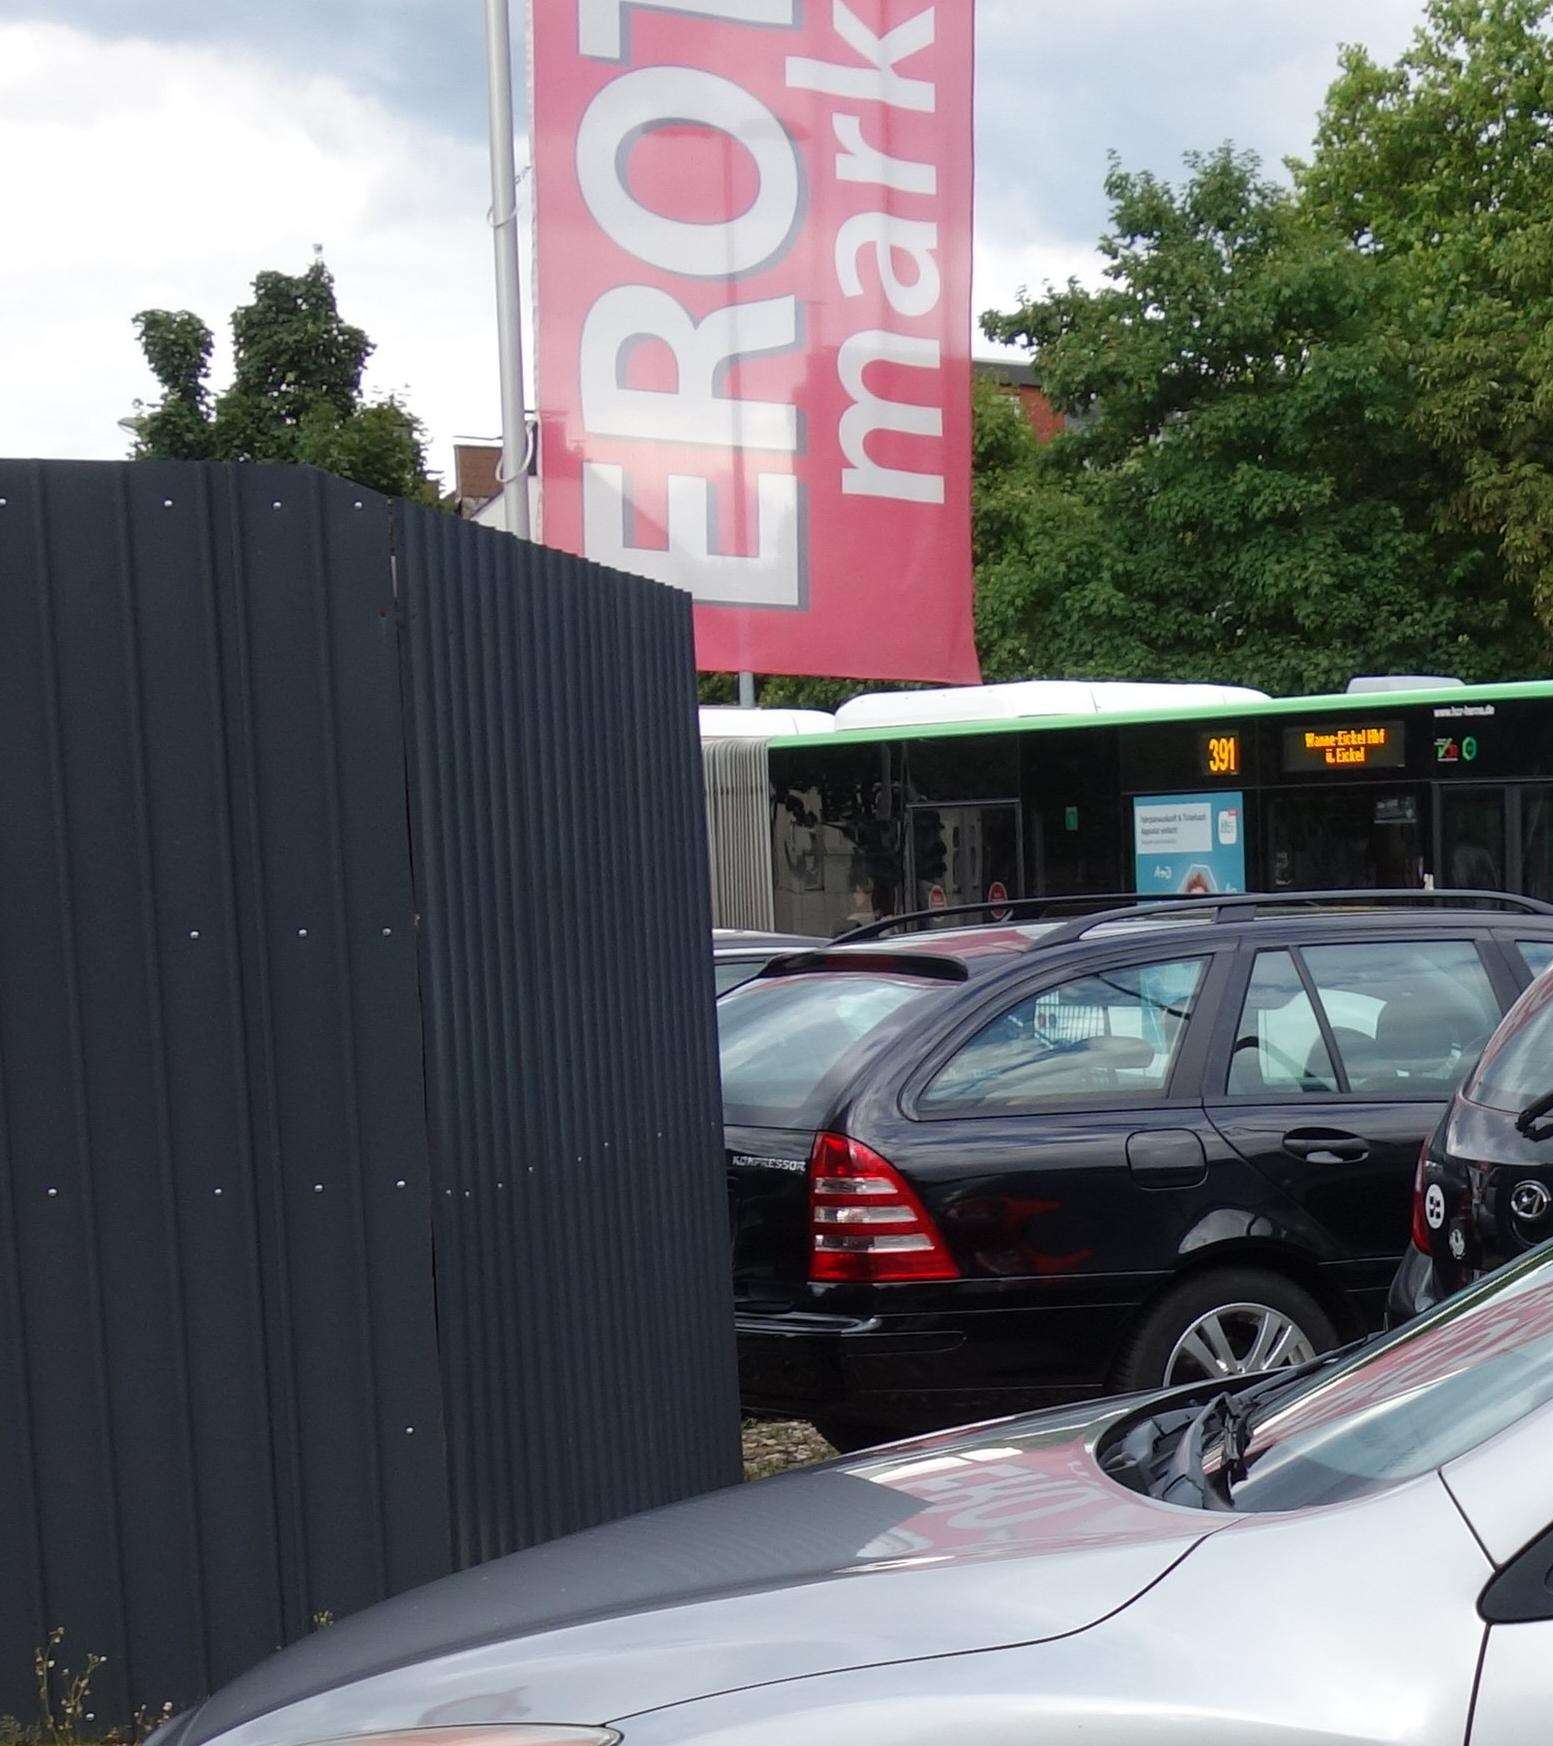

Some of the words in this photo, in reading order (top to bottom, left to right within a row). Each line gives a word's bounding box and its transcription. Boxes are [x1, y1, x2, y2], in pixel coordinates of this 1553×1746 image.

[1304, 729, 1365, 749] Wanne-Eickel
[1366, 727, 1386, 745] Hbf
[1208, 737, 1236, 772] 391
[1336, 746, 1366, 763] Eickel
